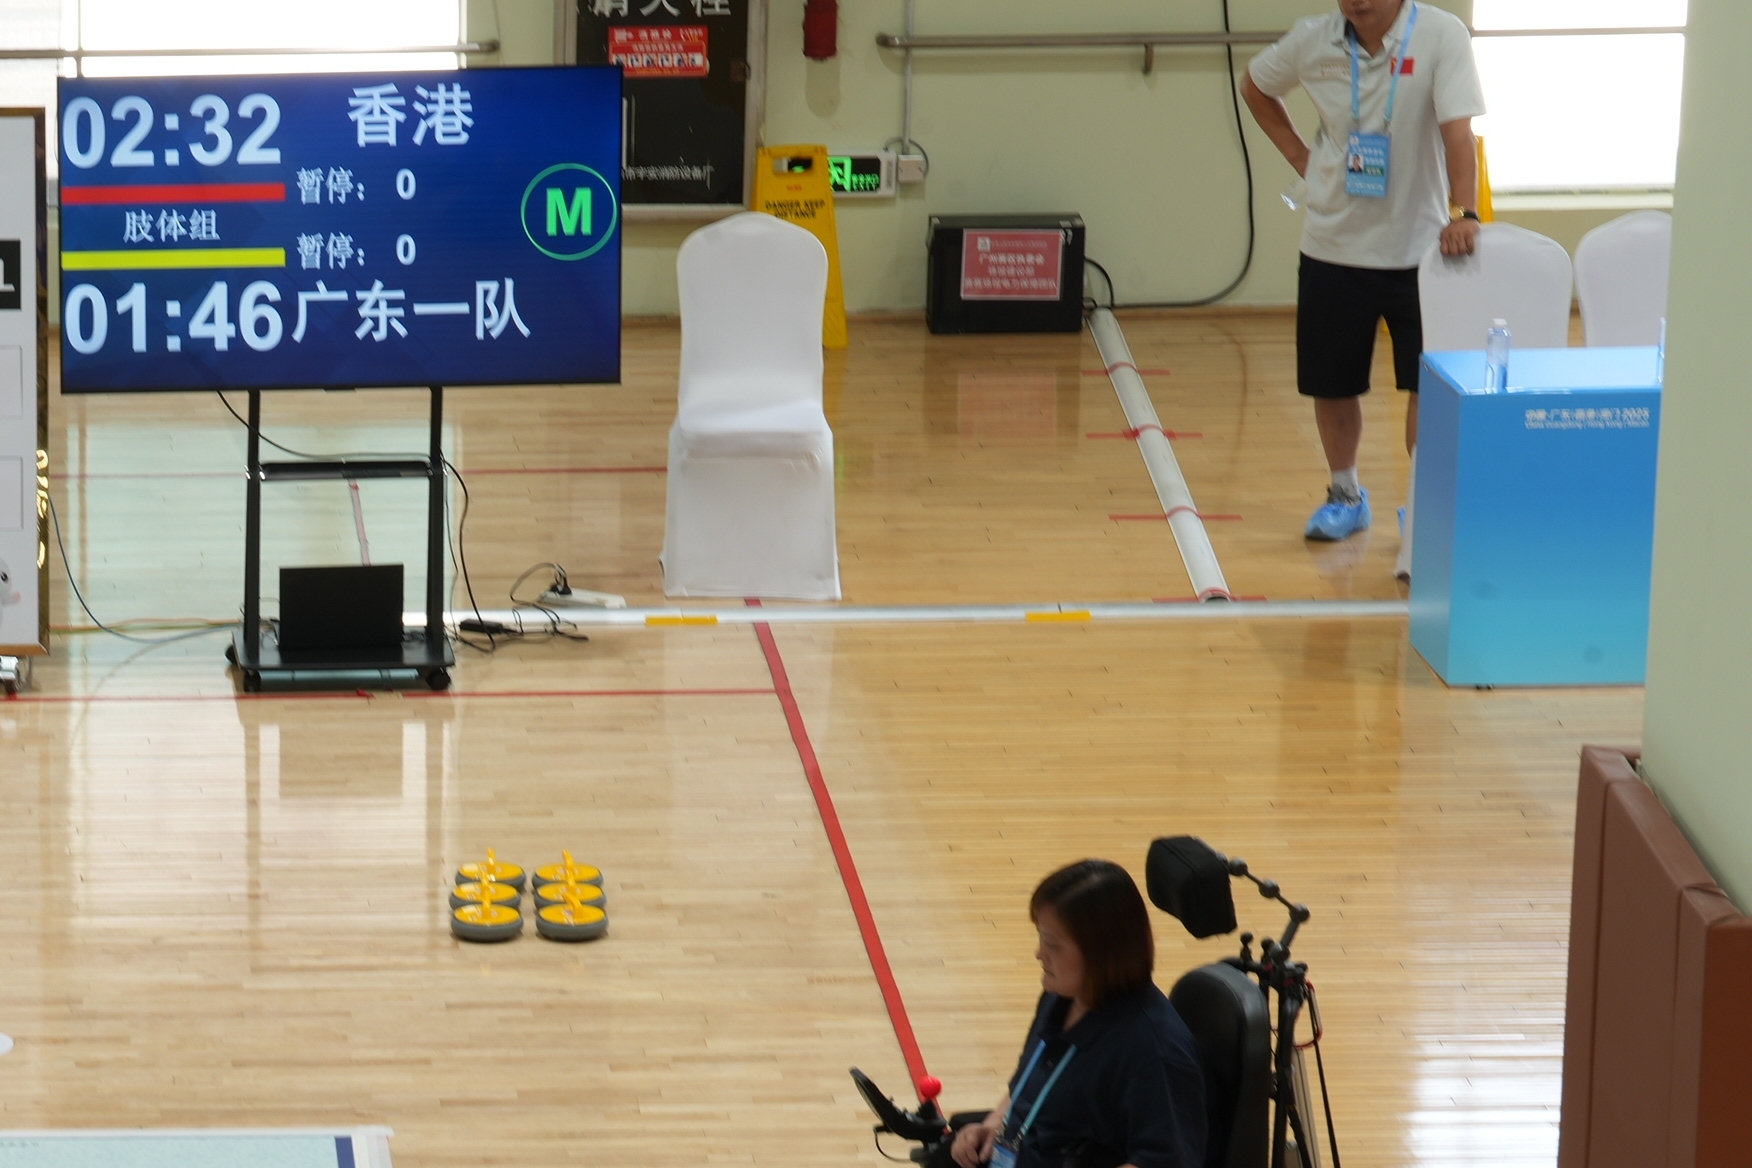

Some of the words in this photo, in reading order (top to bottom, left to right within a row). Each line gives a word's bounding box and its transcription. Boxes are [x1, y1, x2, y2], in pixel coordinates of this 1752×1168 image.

[61, 93, 282, 168] 02:32
[347, 83, 474, 147] 香港
[396, 169, 416, 200] 0
[546, 187, 592, 236] M
[123, 209, 220, 243] 肢体组
[396, 235, 416, 266] 0
[64, 281, 284, 354] 01:46
[291, 277, 531, 343] 广东一队
